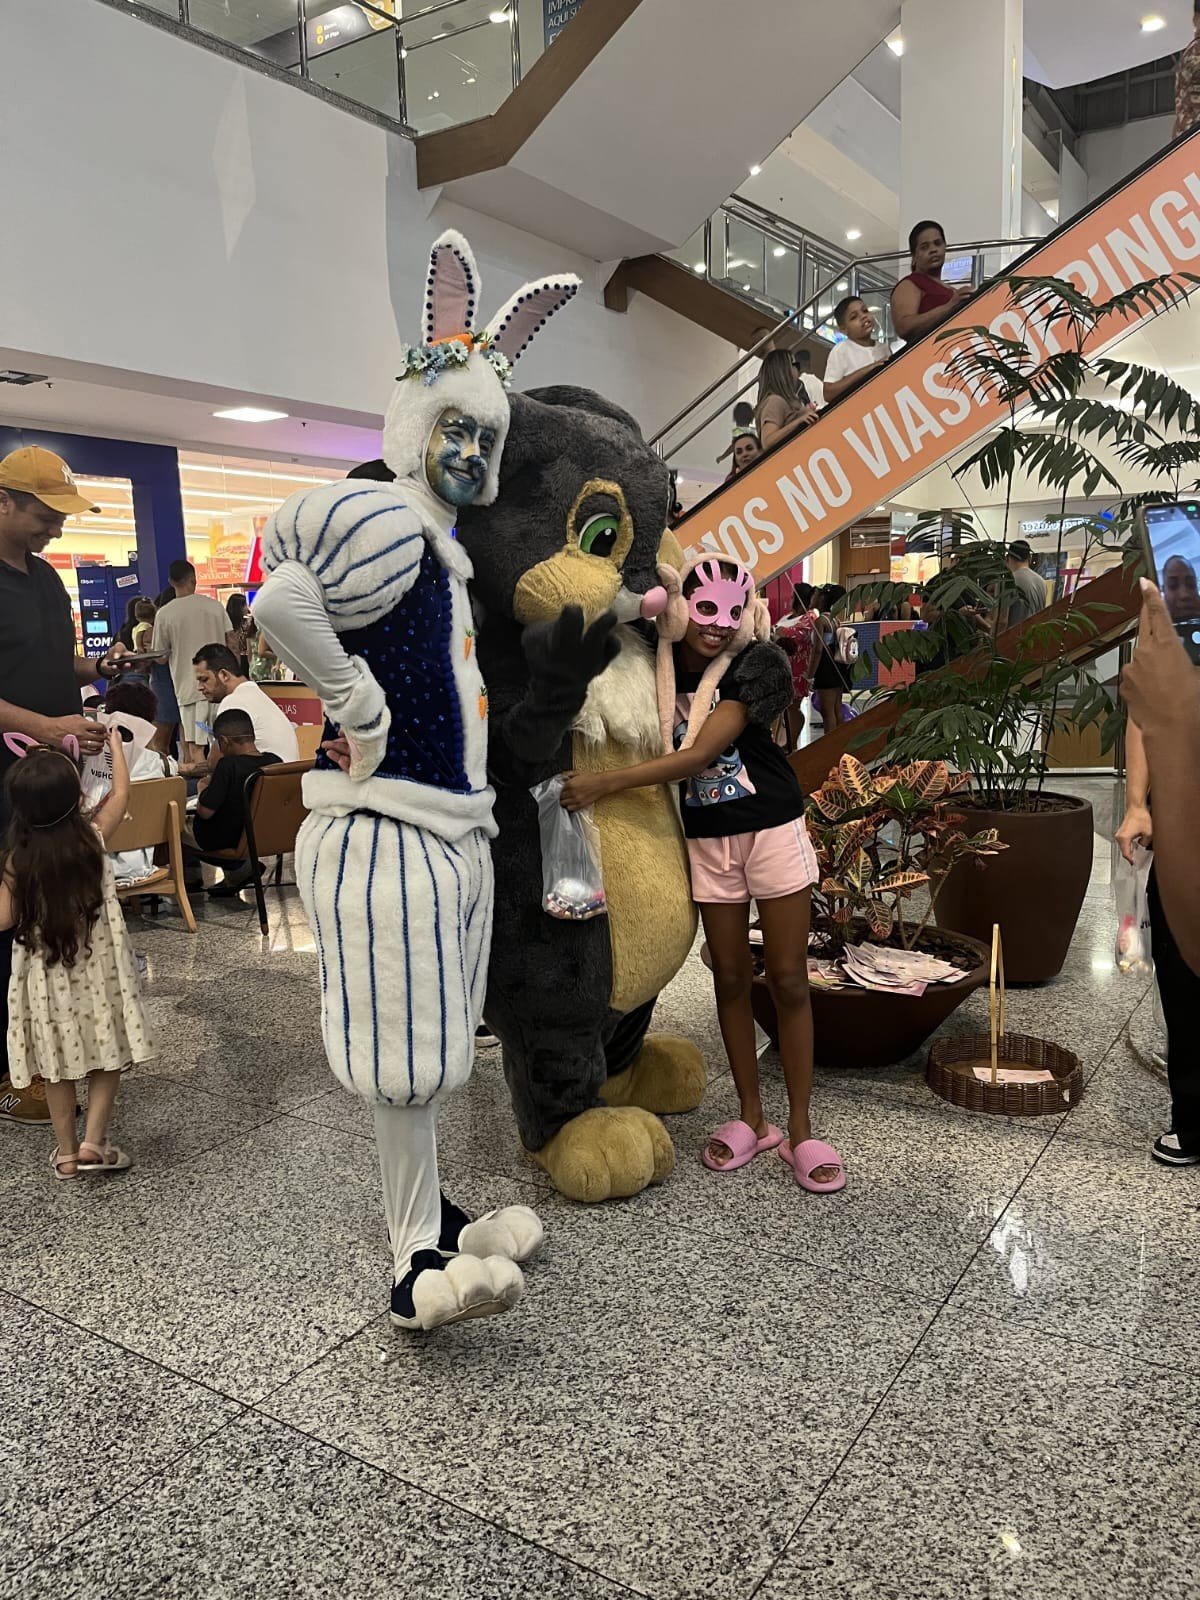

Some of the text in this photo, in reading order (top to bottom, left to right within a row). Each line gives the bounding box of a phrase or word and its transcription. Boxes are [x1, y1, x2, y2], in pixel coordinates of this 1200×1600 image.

[548, 11, 569, 28] AQUI
[776, 447, 852, 532] NO
[86, 637, 113, 647] COM
